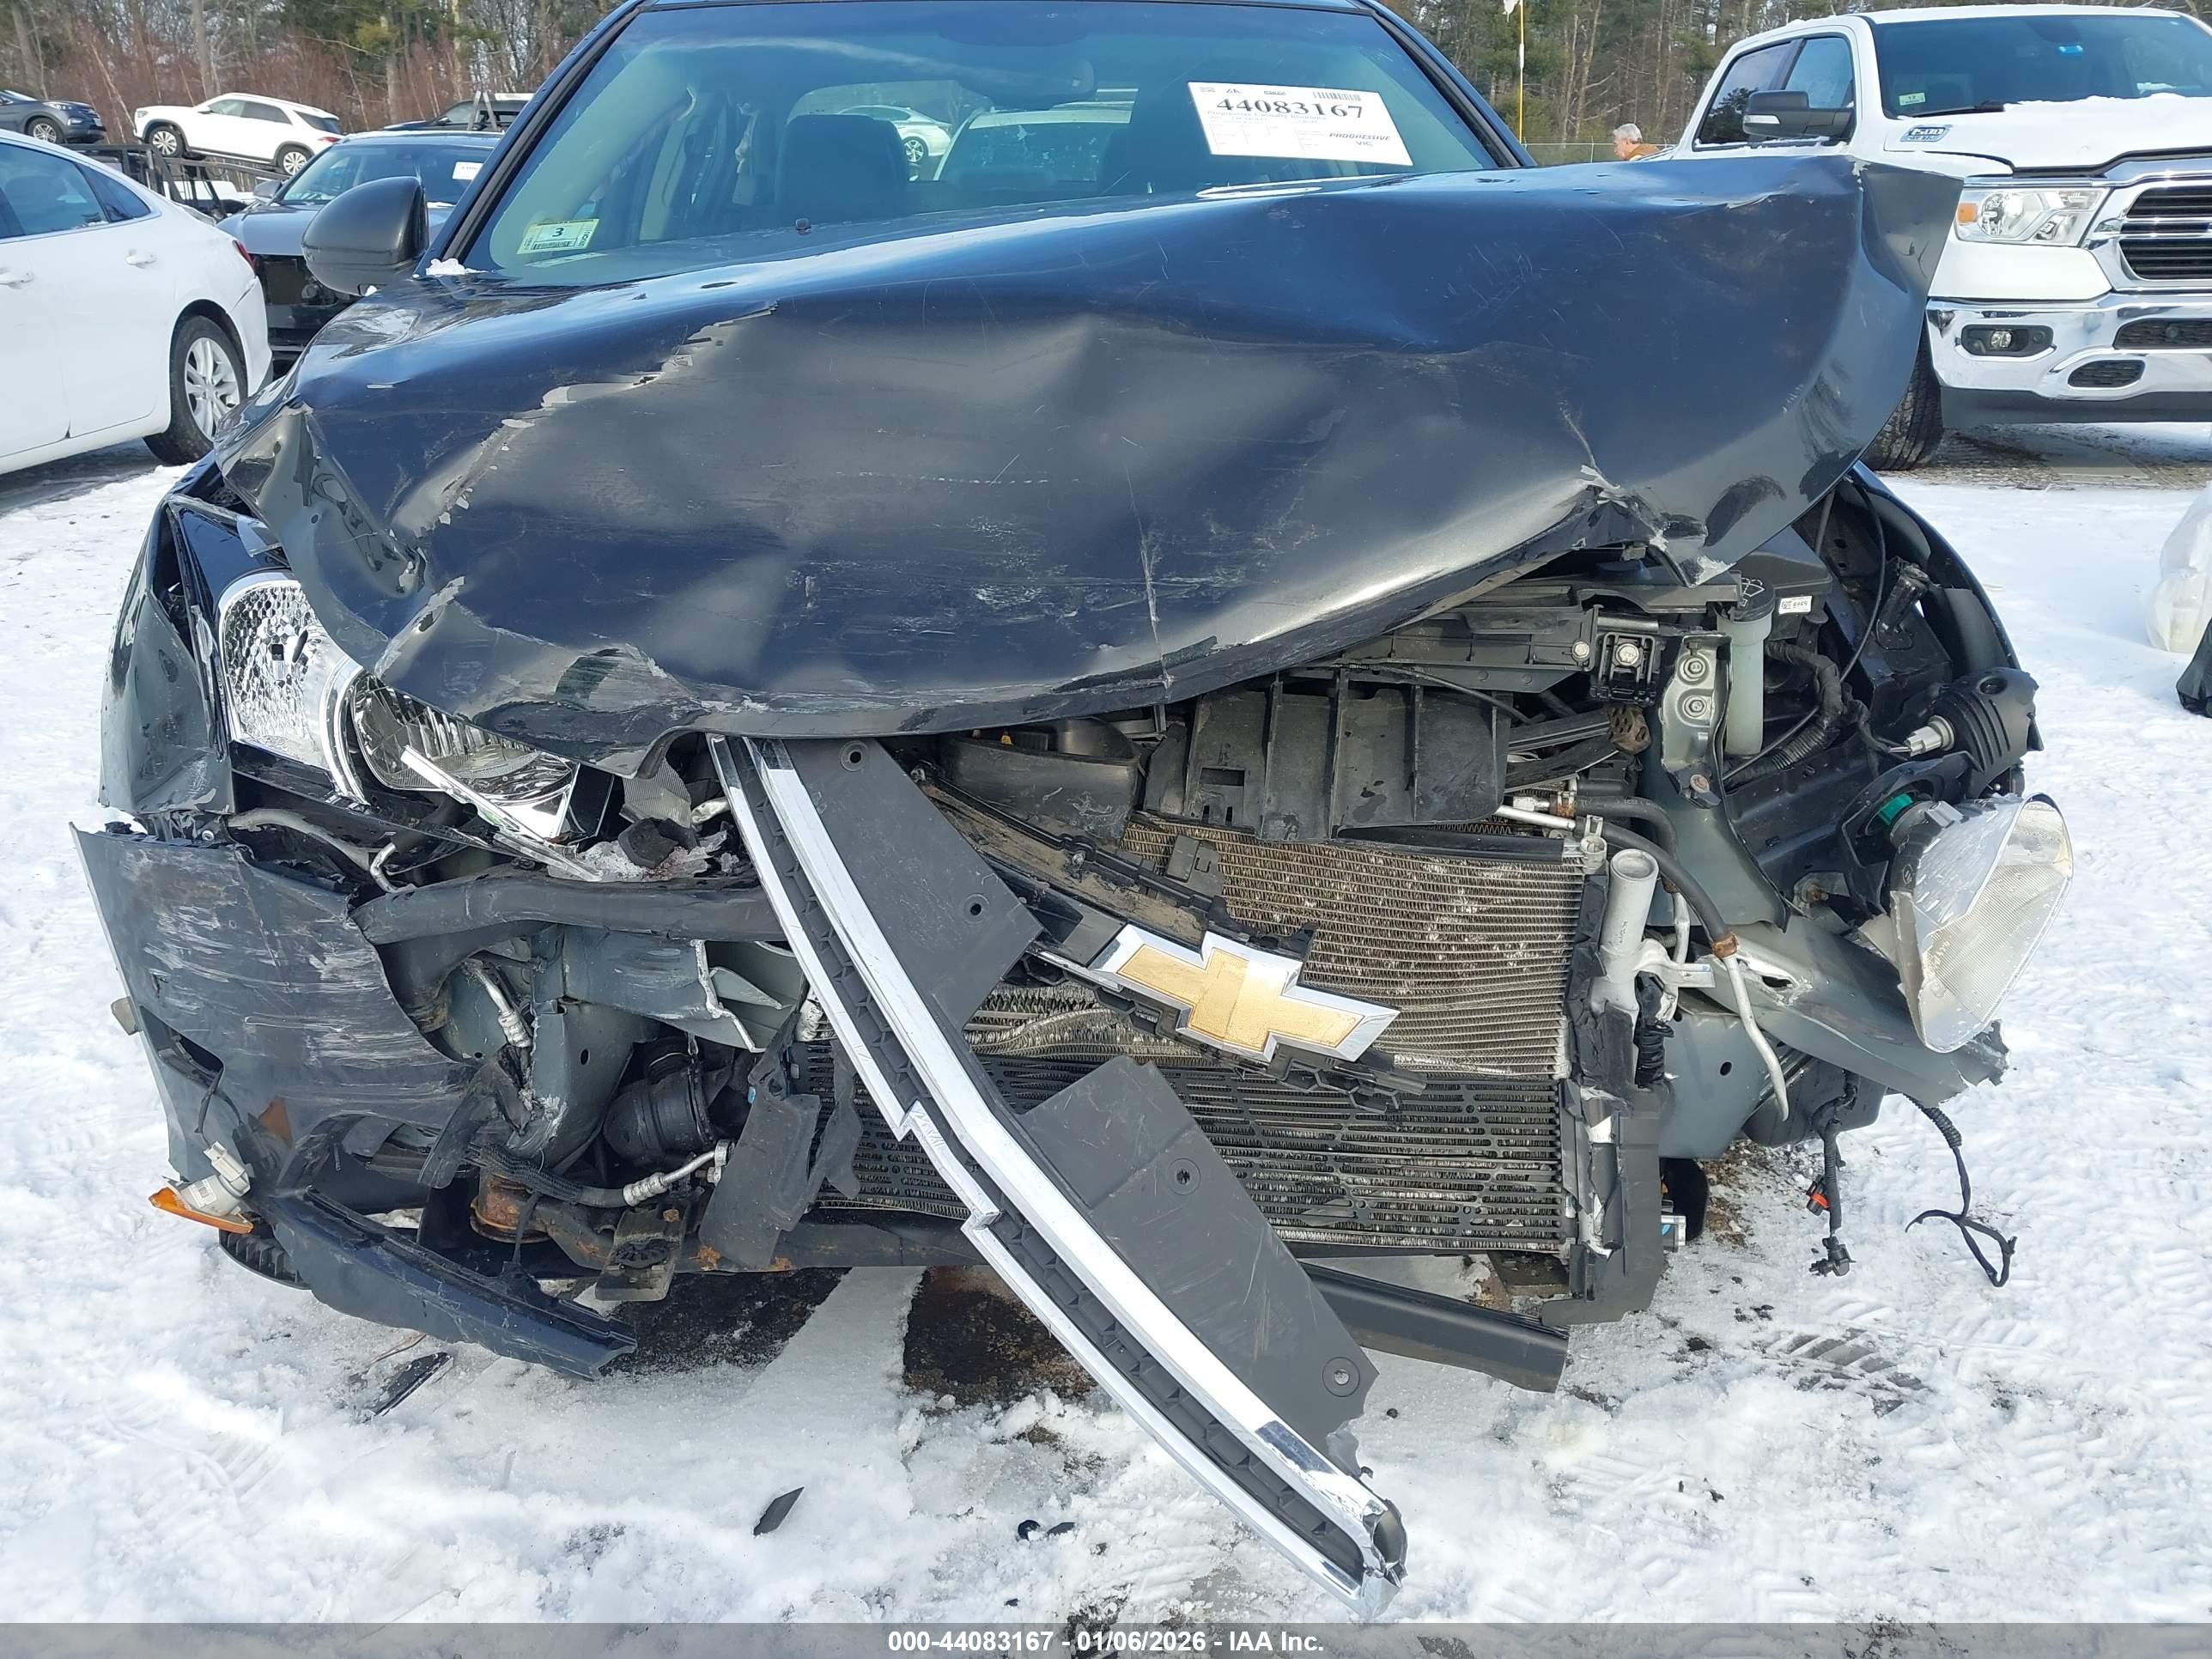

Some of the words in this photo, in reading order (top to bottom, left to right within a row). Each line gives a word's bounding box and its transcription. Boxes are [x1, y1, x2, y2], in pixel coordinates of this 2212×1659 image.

[1216, 98, 1363, 118] 44083167
[1329, 132, 1392, 142] PROGRESSIVE
[552, 228, 564, 237] 3
